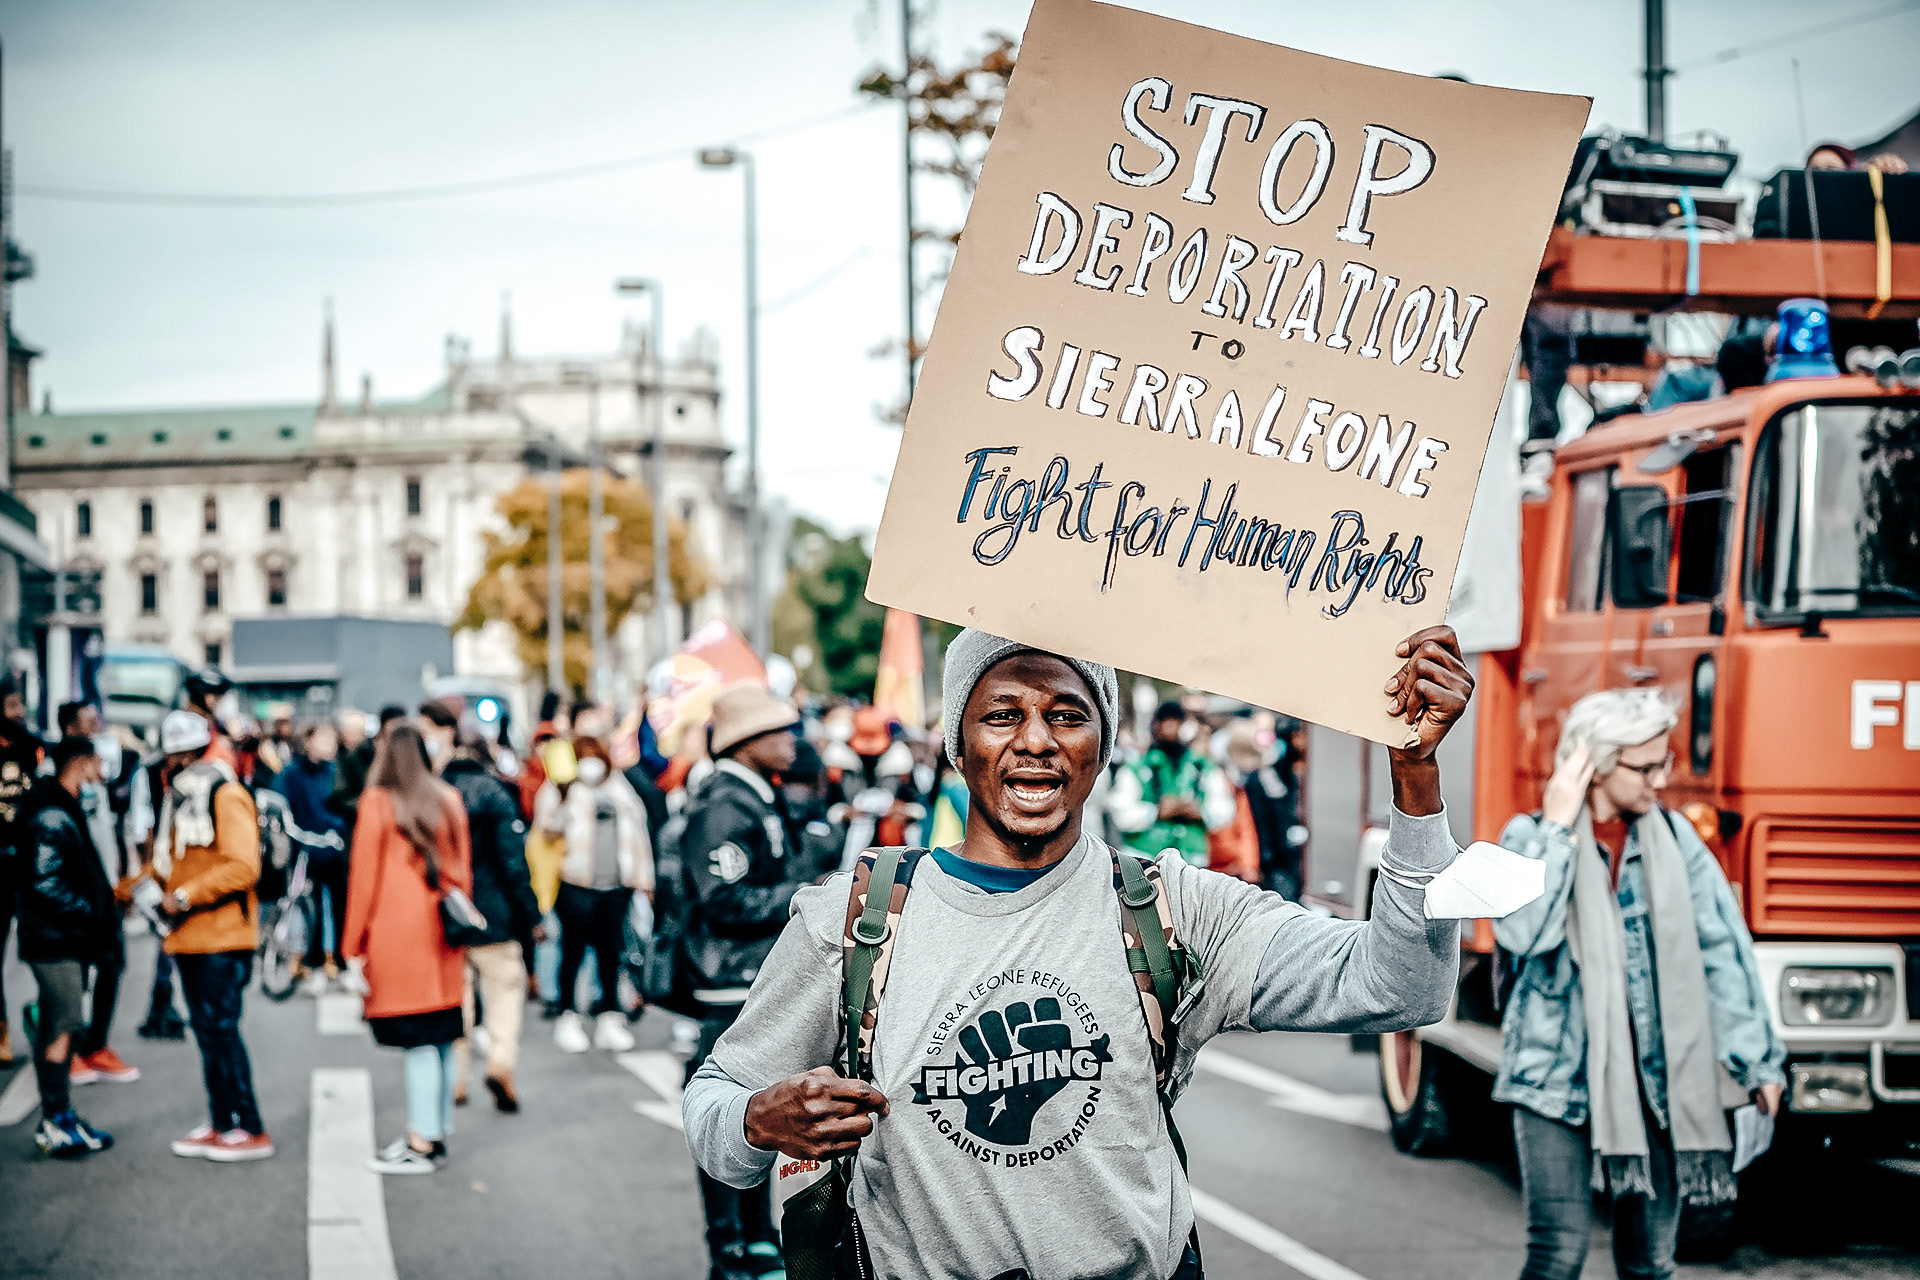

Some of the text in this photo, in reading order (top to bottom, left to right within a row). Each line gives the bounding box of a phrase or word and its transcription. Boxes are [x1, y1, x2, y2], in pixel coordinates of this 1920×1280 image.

[1108, 77, 1437, 249] STOP
[1017, 192, 1488, 379] DEPORTATION
[1191, 330, 1246, 360] TO
[957, 446, 1433, 619] Fight for Human Rights
[926, 969, 1099, 1056] SIERRA LEONE REFUGEES
[925, 1049, 1099, 1096] FIGHTING
[926, 1085, 1102, 1168] AGAINST DEPORTATION
